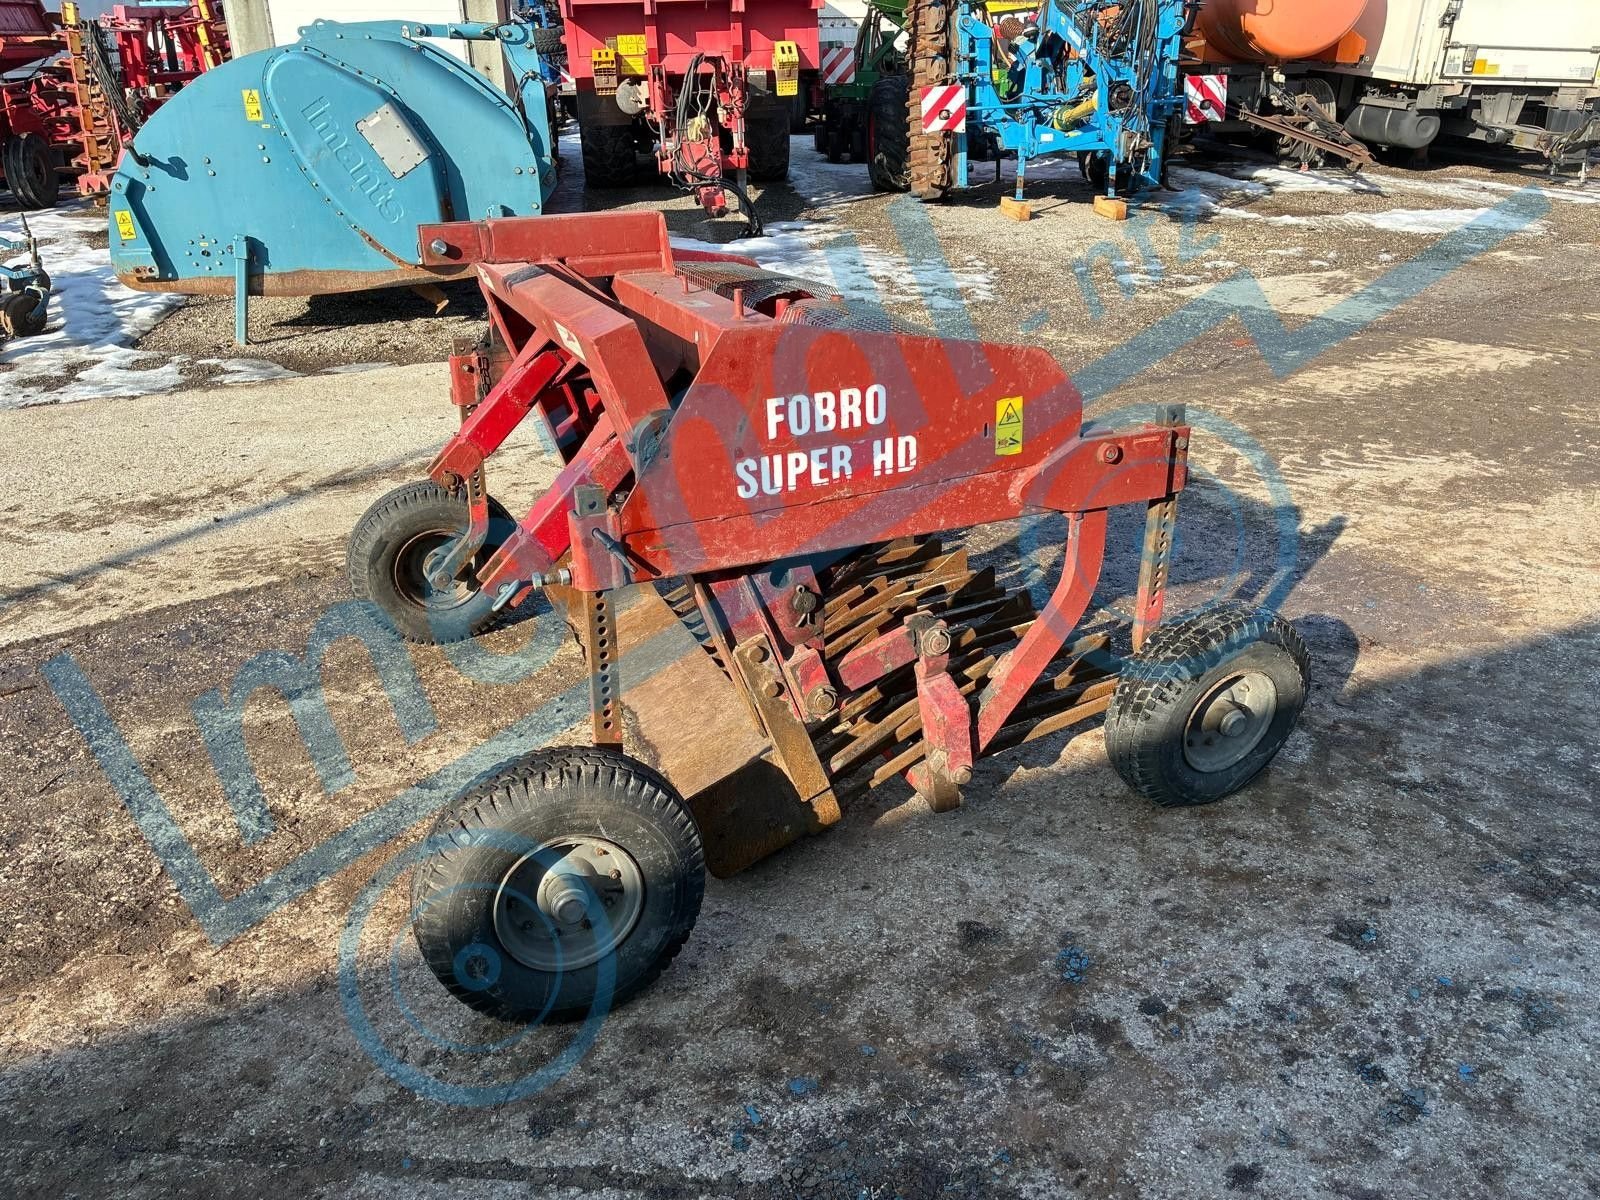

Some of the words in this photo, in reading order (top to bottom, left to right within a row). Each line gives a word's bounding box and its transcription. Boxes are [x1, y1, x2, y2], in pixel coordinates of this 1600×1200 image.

[766, 384, 887, 440] FOBRO
[735, 445, 852, 499] SUPER
[873, 435, 917, 477] HD
